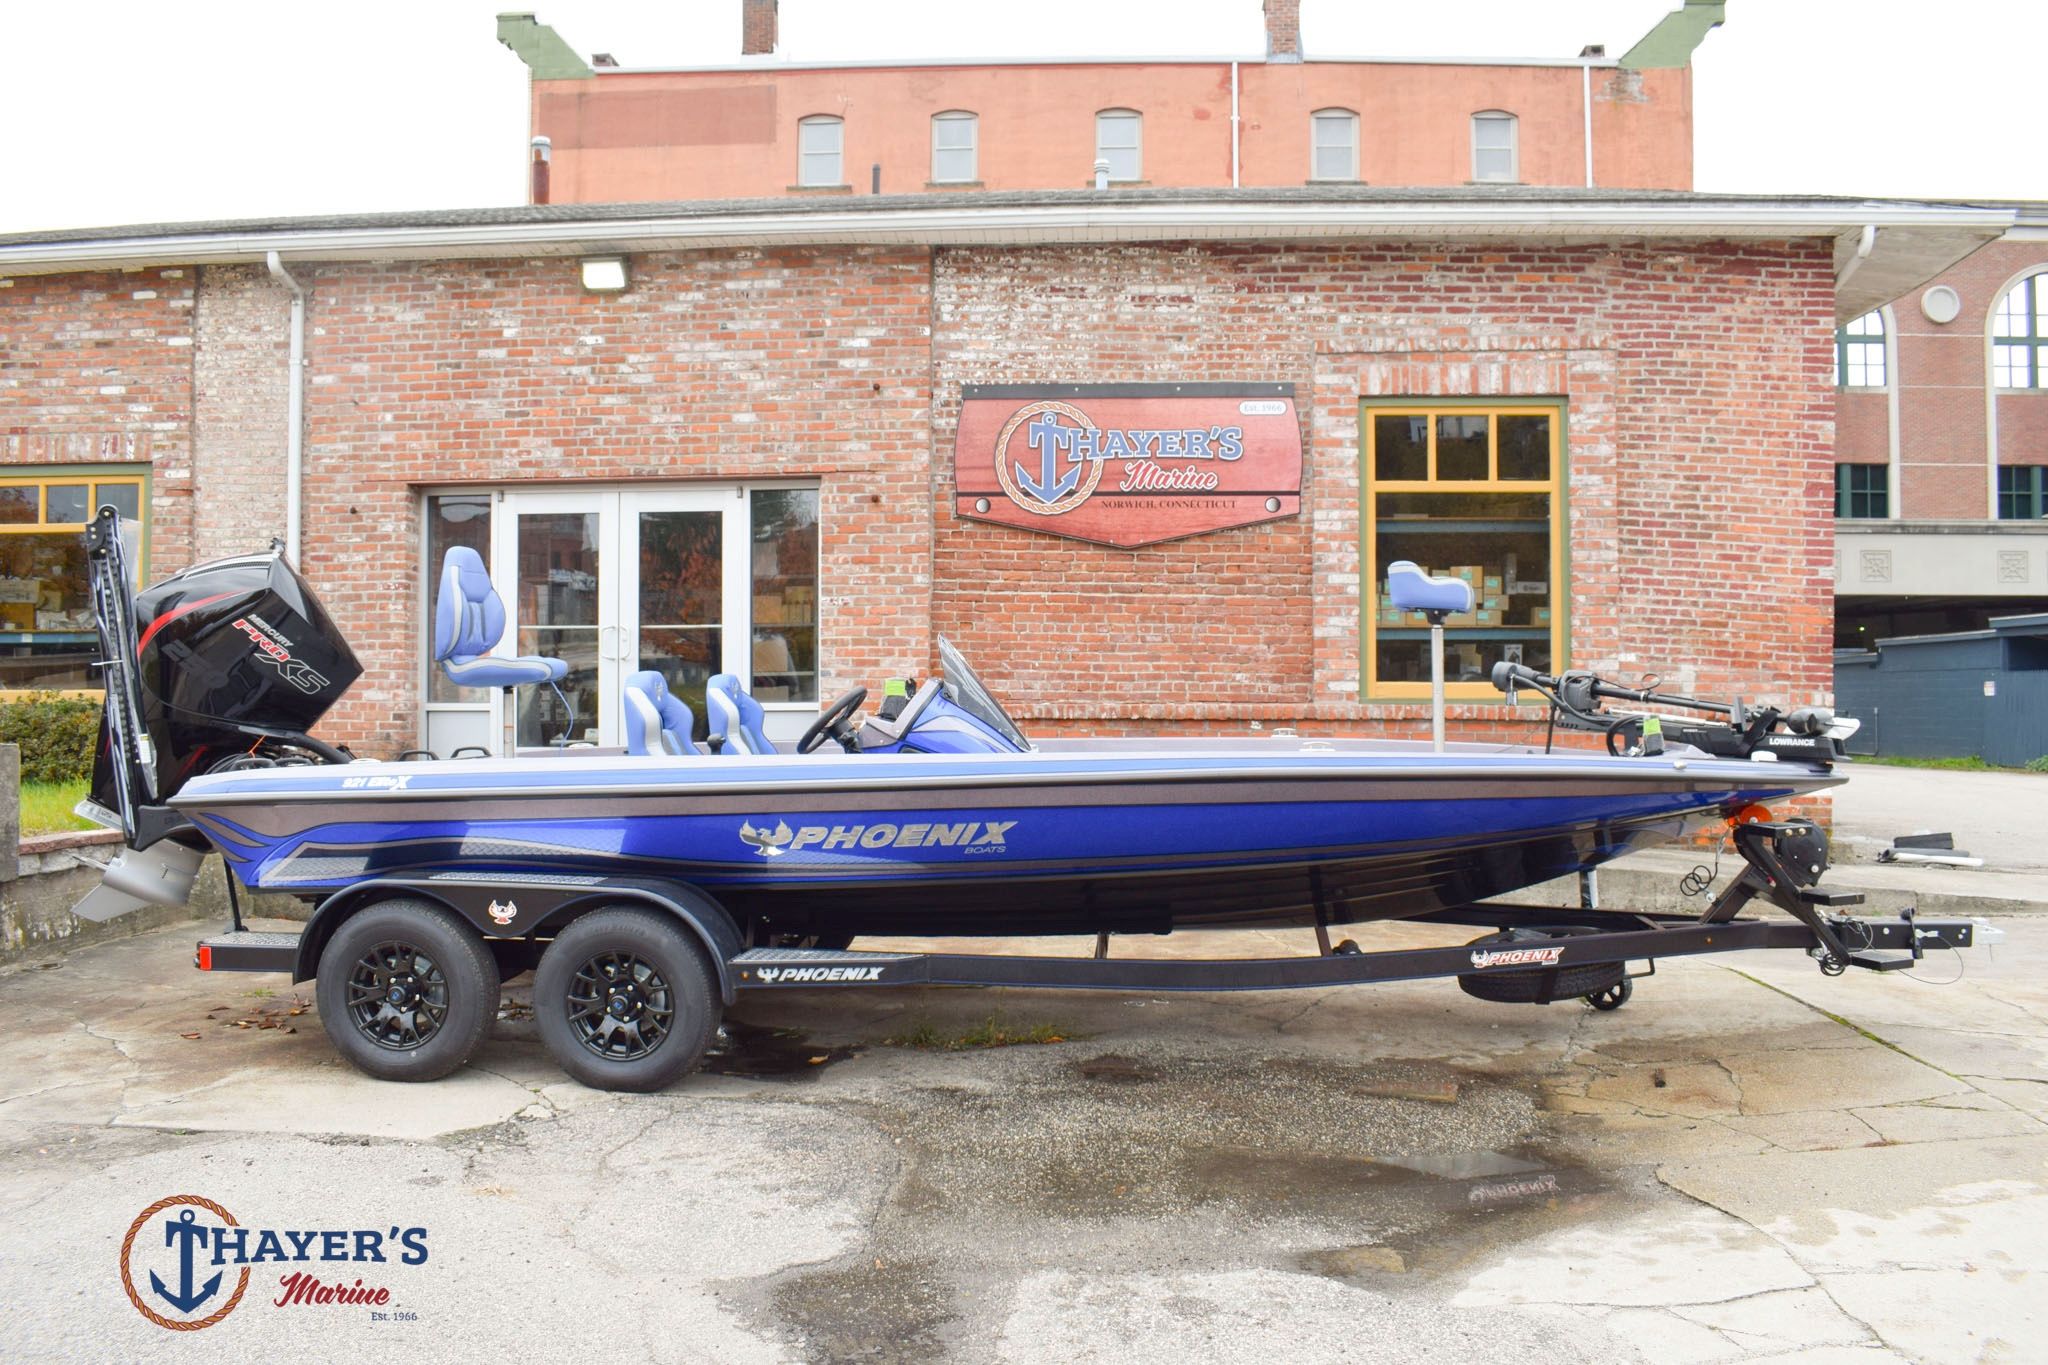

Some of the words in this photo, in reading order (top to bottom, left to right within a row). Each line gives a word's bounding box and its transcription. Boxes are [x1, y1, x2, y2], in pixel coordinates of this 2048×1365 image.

[1119, 459, 1218, 492] Marine
[1101, 500, 1156, 510] NORWICH,
[1158, 500, 1238, 510] CONNECTICUT
[232, 619, 290, 662] PRO
[247, 614, 294, 647] MERCURY
[253, 653, 330, 695] XS
[1769, 738, 1815, 747] LOWRANCE
[790, 821, 1018, 849] PHOENIX
[964, 846, 1006, 854] BOATS
[1488, 948, 1563, 963] PHOENIX
[778, 967, 885, 982] PHOENIX
